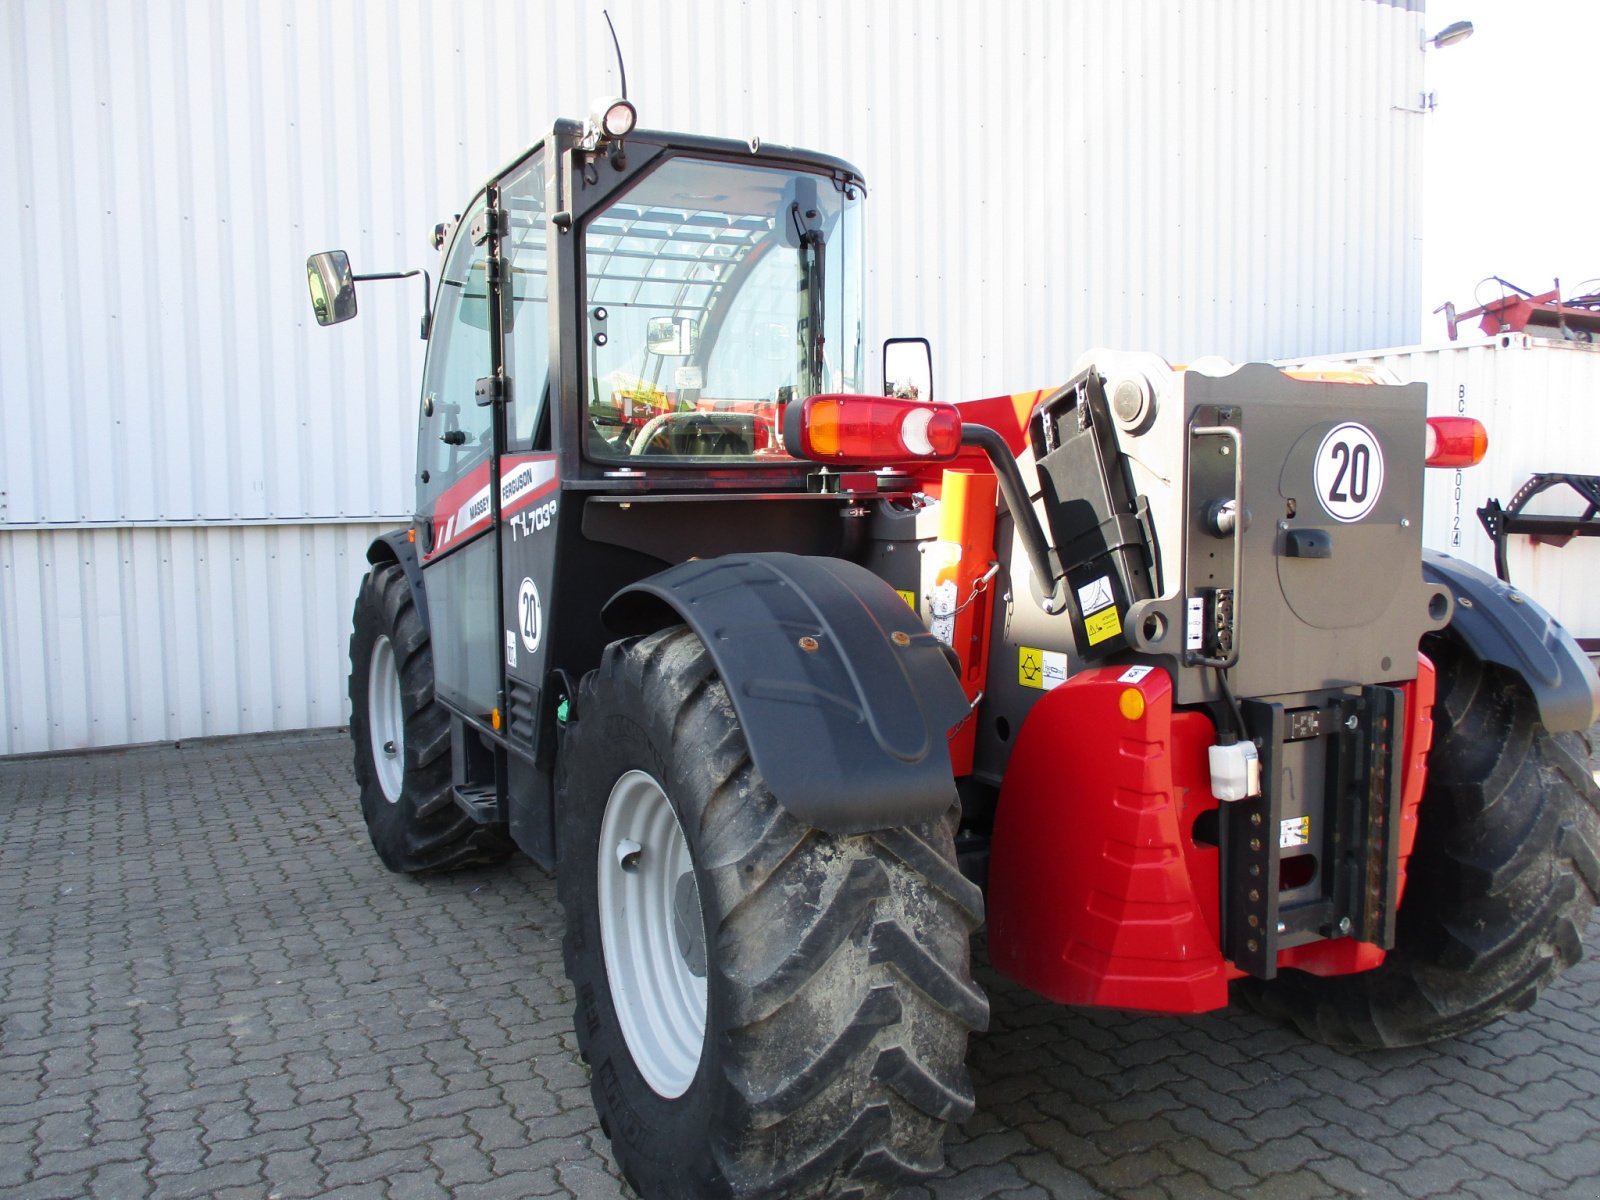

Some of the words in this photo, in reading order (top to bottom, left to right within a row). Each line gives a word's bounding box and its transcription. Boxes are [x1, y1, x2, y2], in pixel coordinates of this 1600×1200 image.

[1457, 384, 1465, 416] BC
[469, 494, 489, 520] MASSEY
[502, 467, 533, 502] FERGUSON
[1329, 441, 1370, 504] 20
[522, 591, 537, 640] 20
